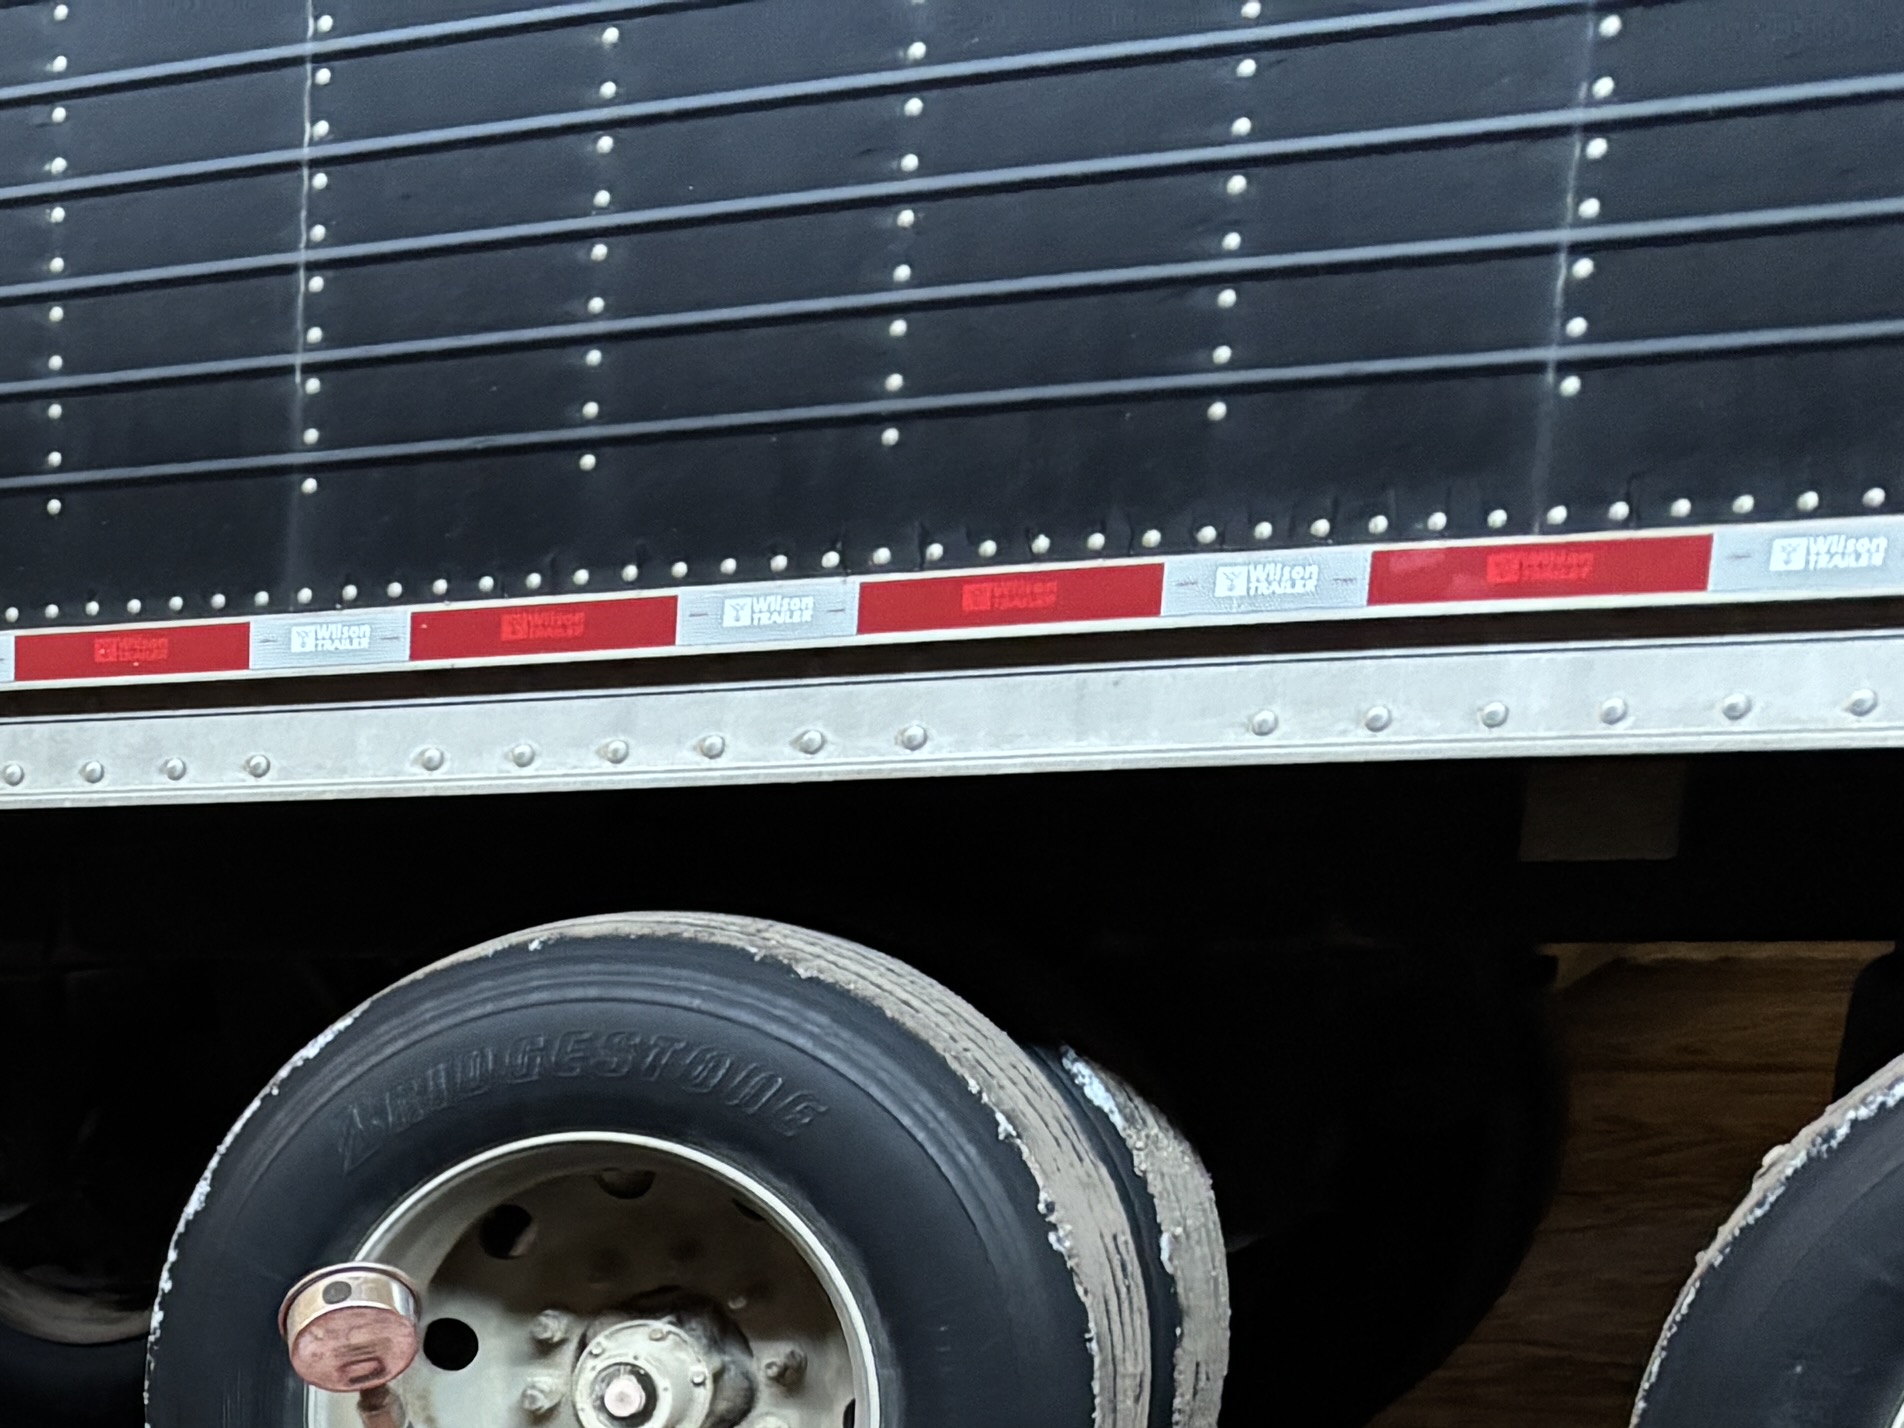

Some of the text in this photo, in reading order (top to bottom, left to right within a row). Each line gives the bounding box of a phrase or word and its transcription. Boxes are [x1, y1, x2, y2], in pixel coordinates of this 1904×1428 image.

[1809, 535, 1888, 553] Wilson
[1249, 562, 1319, 581] Wilson
[752, 595, 814, 612] Wilson
[752, 609, 813, 626] TRAILER
[316, 624, 371, 639] Wilson
